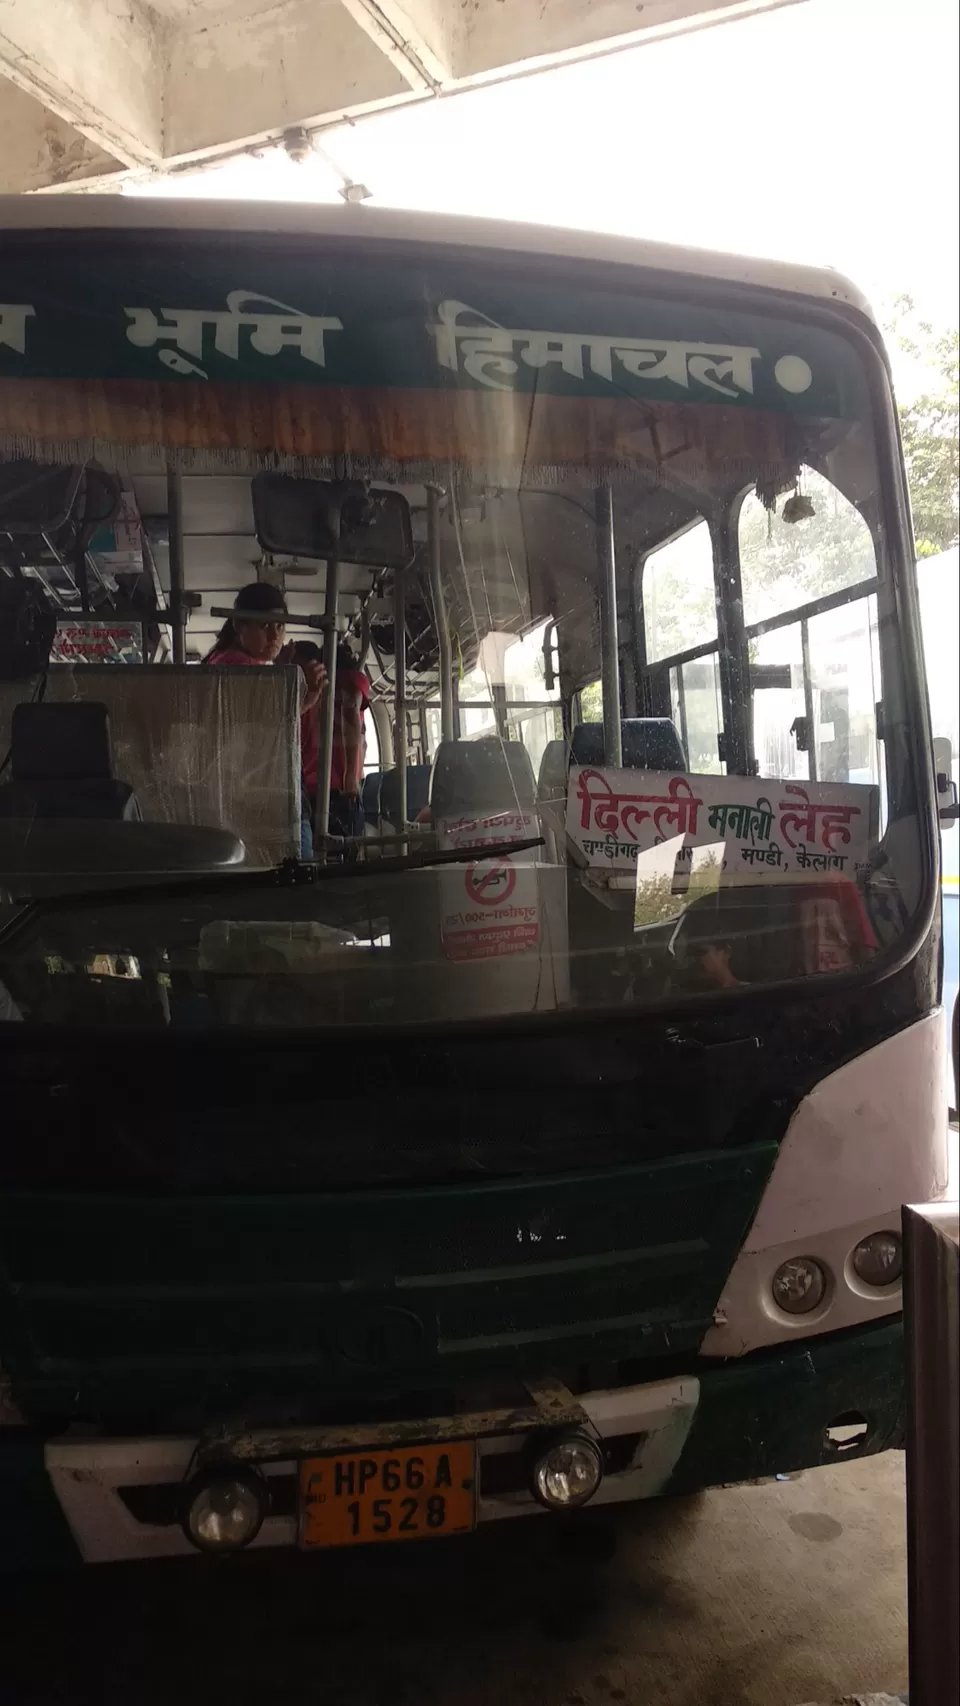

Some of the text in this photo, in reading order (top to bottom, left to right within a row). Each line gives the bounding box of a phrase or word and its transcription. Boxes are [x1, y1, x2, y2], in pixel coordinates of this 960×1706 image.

[123, 289, 344, 380] भूमि
[427, 299, 761, 398] हिमाचल
[576, 768, 703, 842] दिल्ली
[708, 797, 776, 846] मनाली
[778, 785, 862, 853] लेह
[740, 841, 789, 873] मण्डी,
[347, 1494, 447, 1536] 1528
